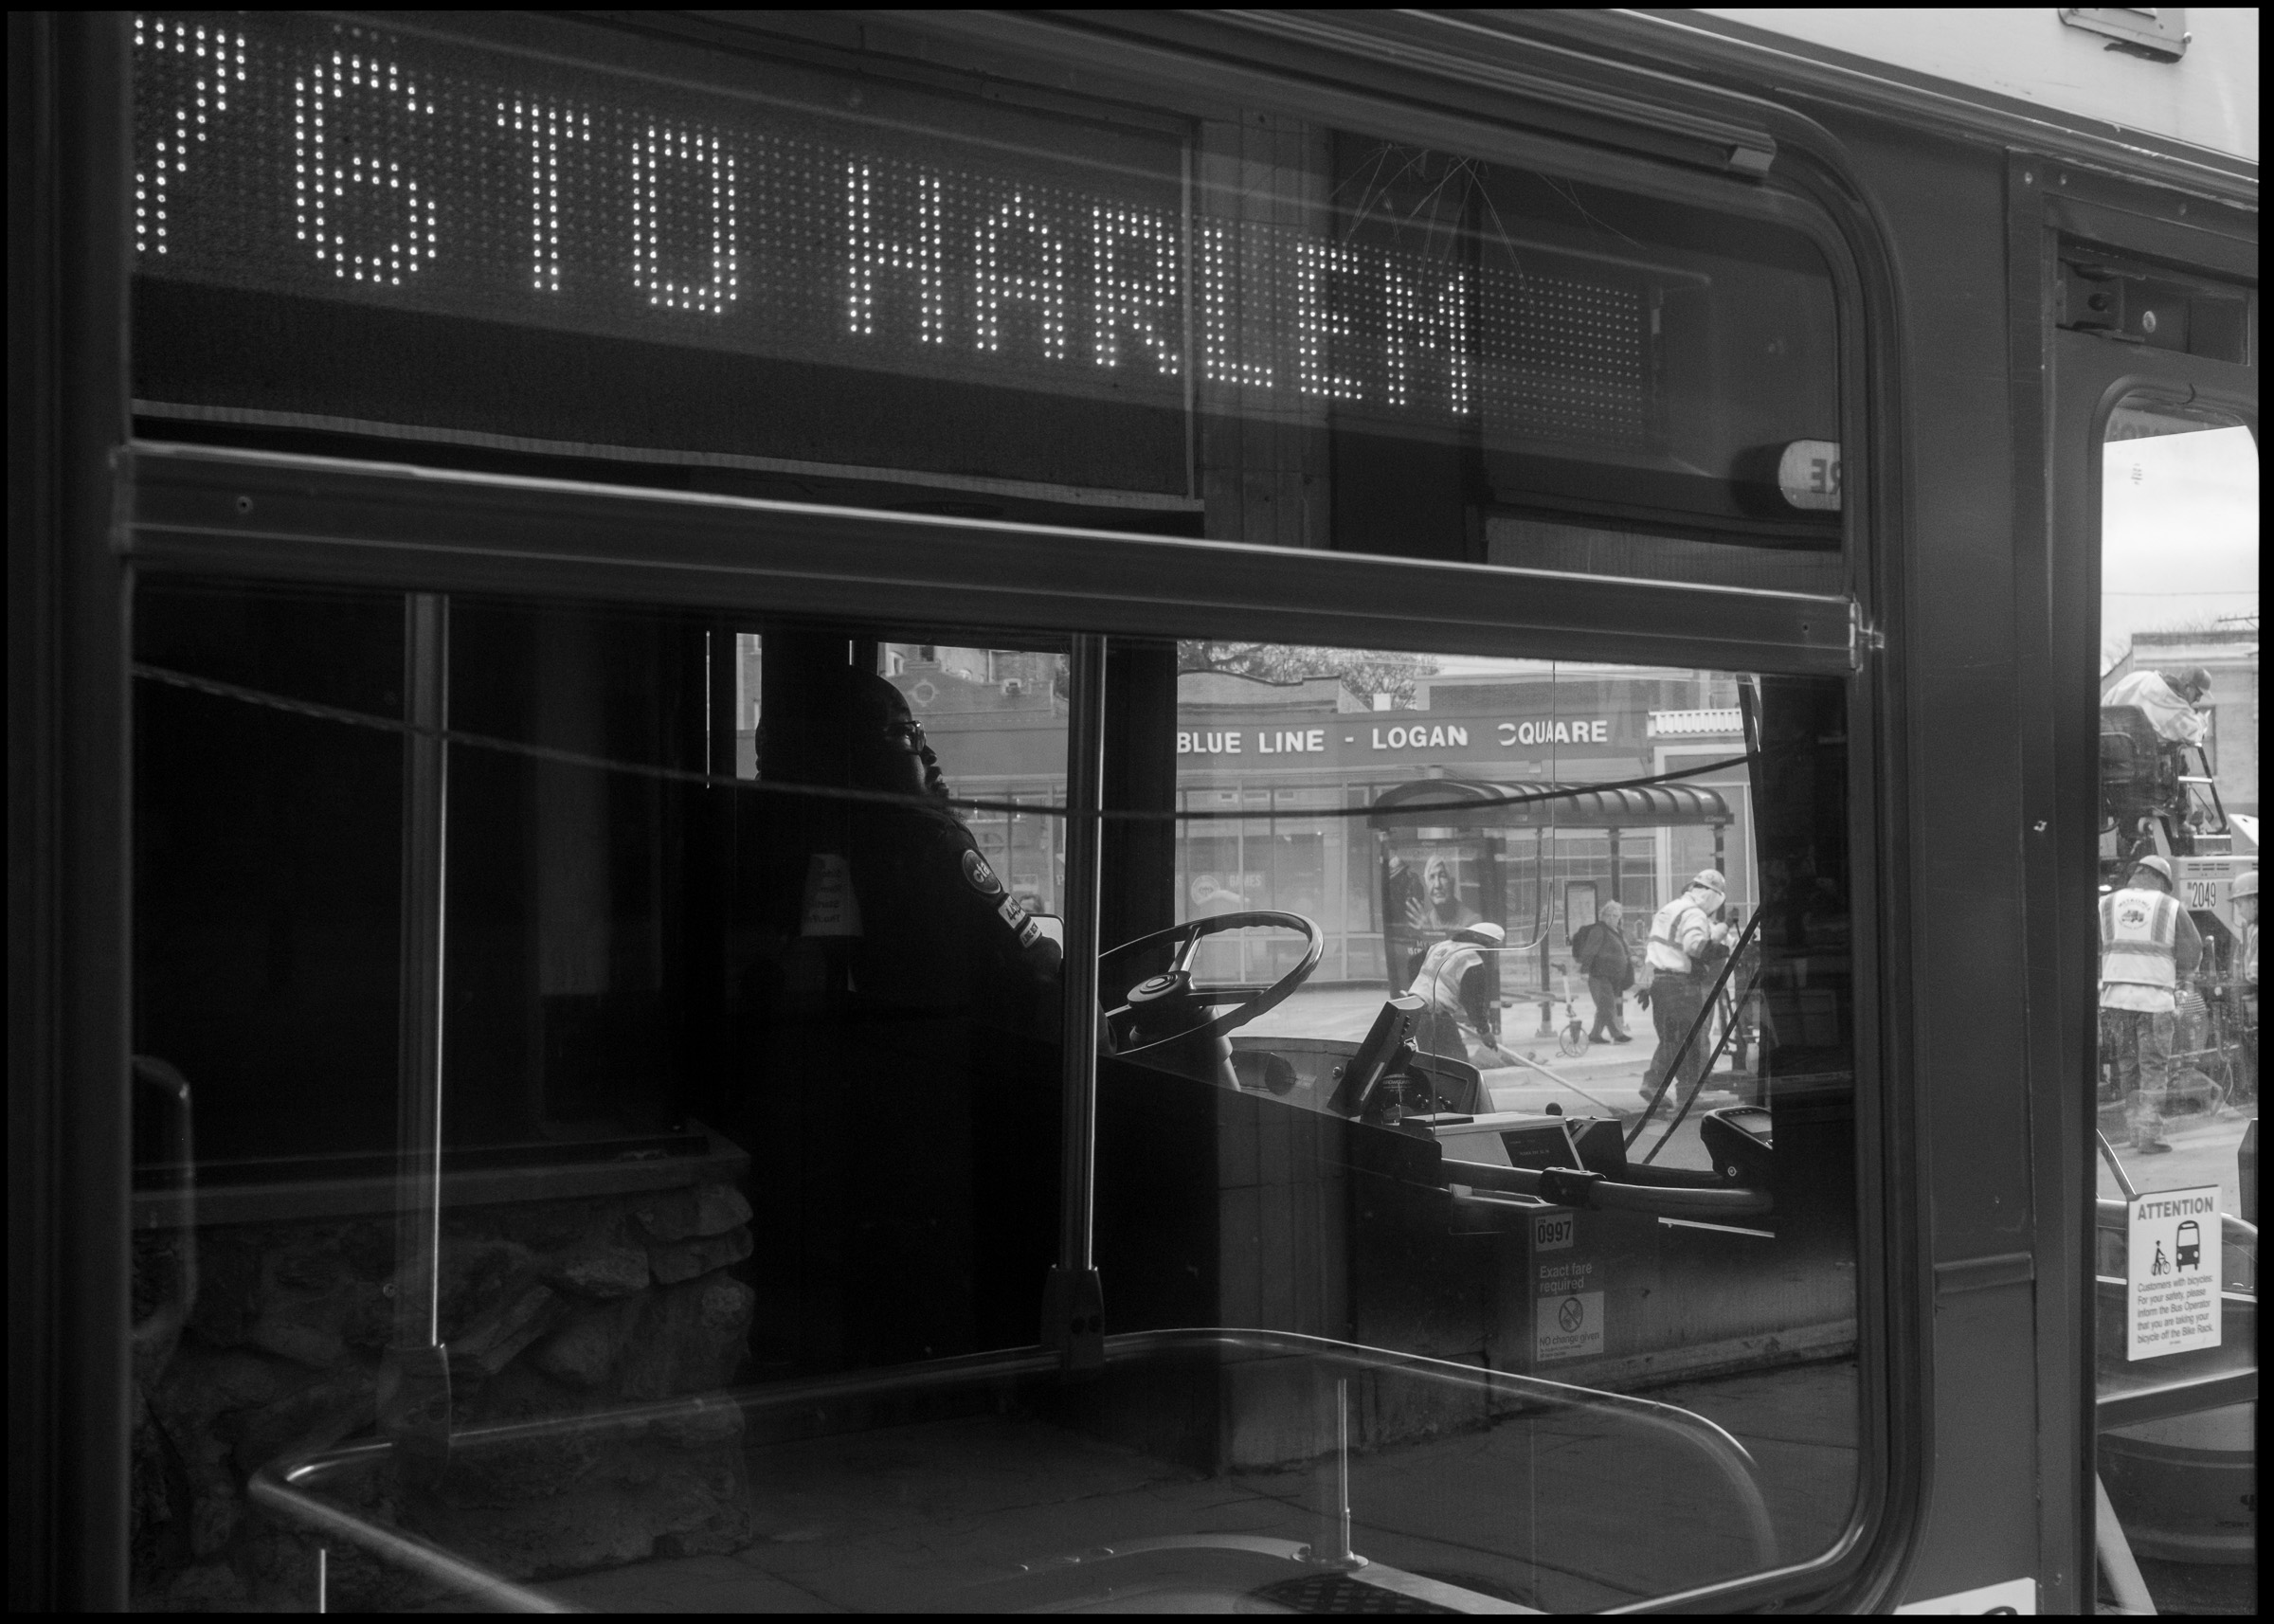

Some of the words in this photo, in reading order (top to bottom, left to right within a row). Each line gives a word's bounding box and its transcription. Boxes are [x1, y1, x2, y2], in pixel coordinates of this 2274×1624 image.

[496, 101, 737, 315] TO
[847, 164, 1470, 415] HARLEM
[1177, 731, 1241, 753] BLUE
[1258, 730, 1325, 753] LINE
[1372, 725, 1468, 749] LOGAN
[973, 861, 991, 883] cta
[2192, 882, 2216, 908] 2049
[2138, 1196, 2214, 1221] ATTENTION
[1537, 1219, 1572, 1244] 0997
[1540, 1264, 1569, 1278] Exact
[1571, 1262, 1593, 1275] fare
[1540, 1275, 1584, 1294] required
[2138, 1282, 2172, 1292] Customers
[2173, 1277, 2186, 1287] with
[2138, 1295, 2147, 1305] For
[2150, 1294, 2164, 1307] your
[2187, 1288, 2207, 1300] please
[2138, 1308, 2158, 1318] inform
[2158, 1305, 2170, 1315] the
[2170, 1303, 2183, 1313] Bus
[2184, 1300, 2211, 1312] Operator
[2138, 1321, 2150, 1331] that
[2151, 1320, 2162, 1331] you
[2164, 1318, 2175, 1326] are
[2175, 1314, 2194, 1326] taking
[2195, 1312, 2210, 1324] your
[1539, 1336, 1551, 1346] NO
[1552, 1334, 1579, 1345] change
[1579, 1331, 1599, 1344] given
[2138, 1332, 2159, 1344] bicycle
[2160, 1328, 2170, 1340] off
[2171, 1328, 2181, 1339] the
[2182, 1326, 2195, 1336] Bike
